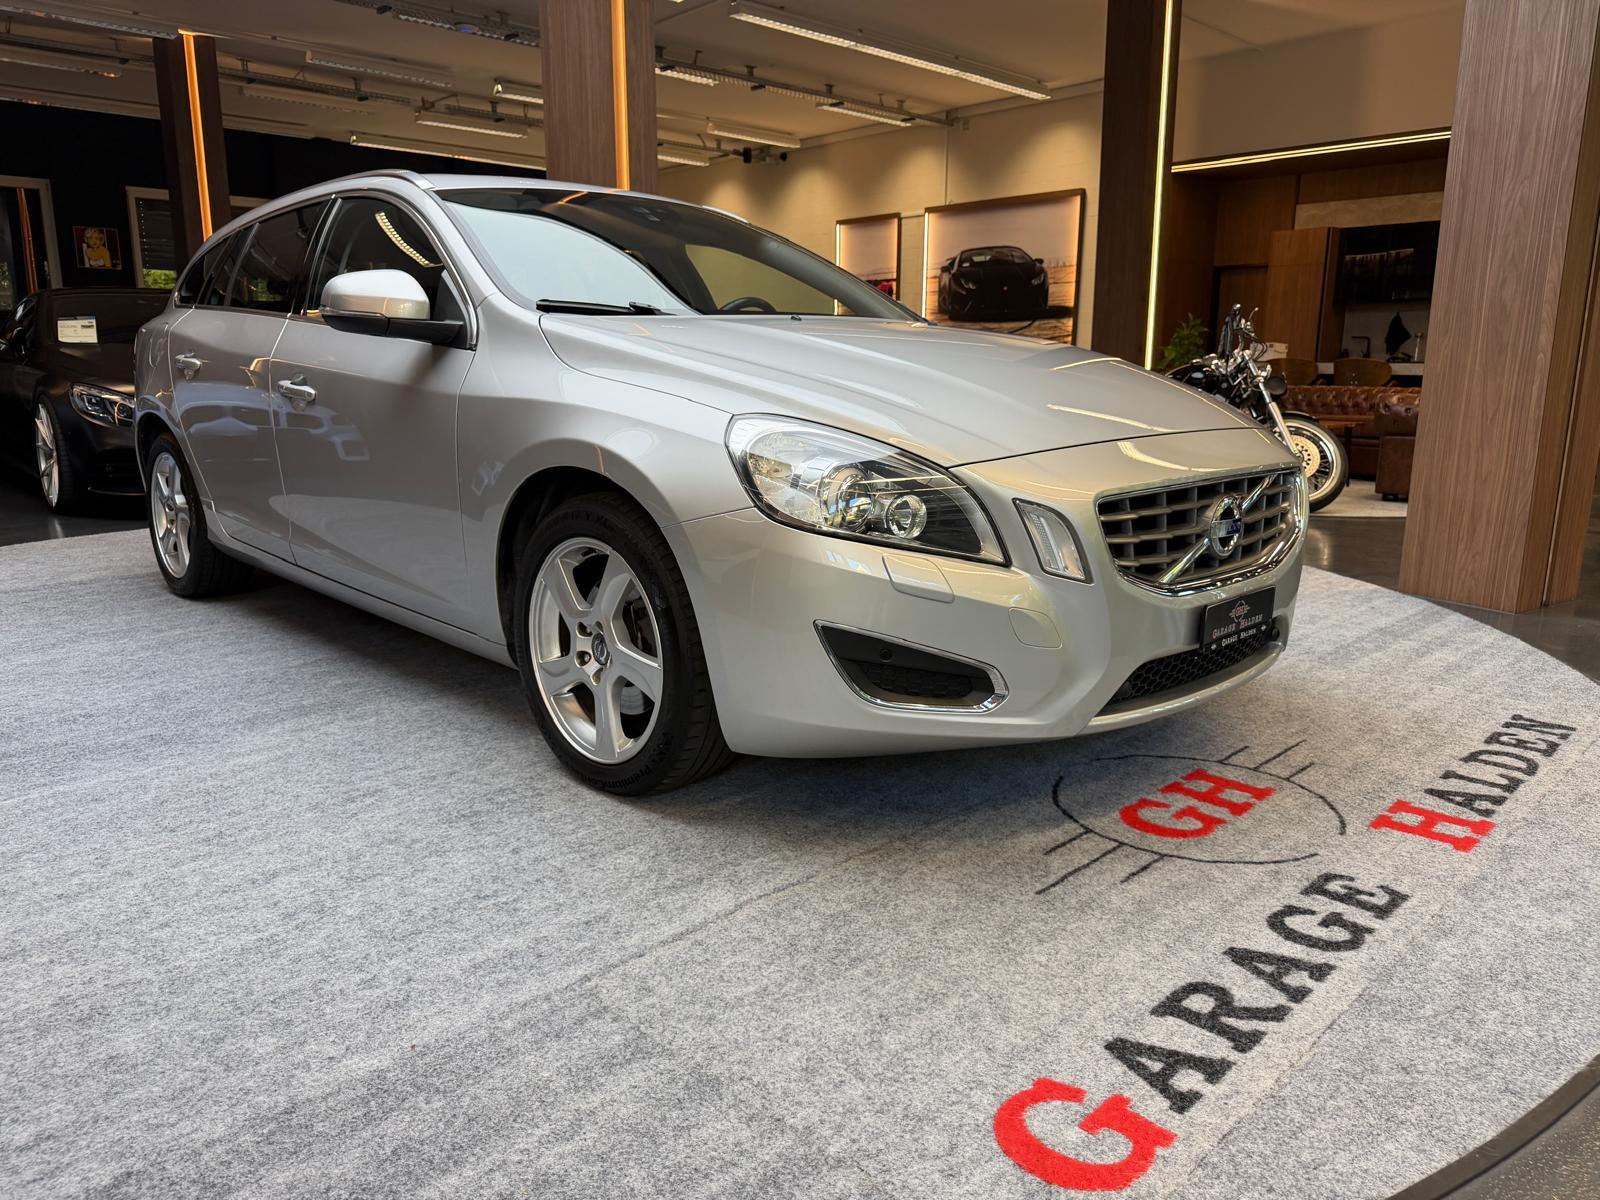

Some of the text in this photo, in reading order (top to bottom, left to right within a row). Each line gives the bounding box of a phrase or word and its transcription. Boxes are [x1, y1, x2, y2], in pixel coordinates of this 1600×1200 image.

[1118, 768, 1277, 839] GH
[993, 714, 1577, 1192] GARAGE HALDEN
